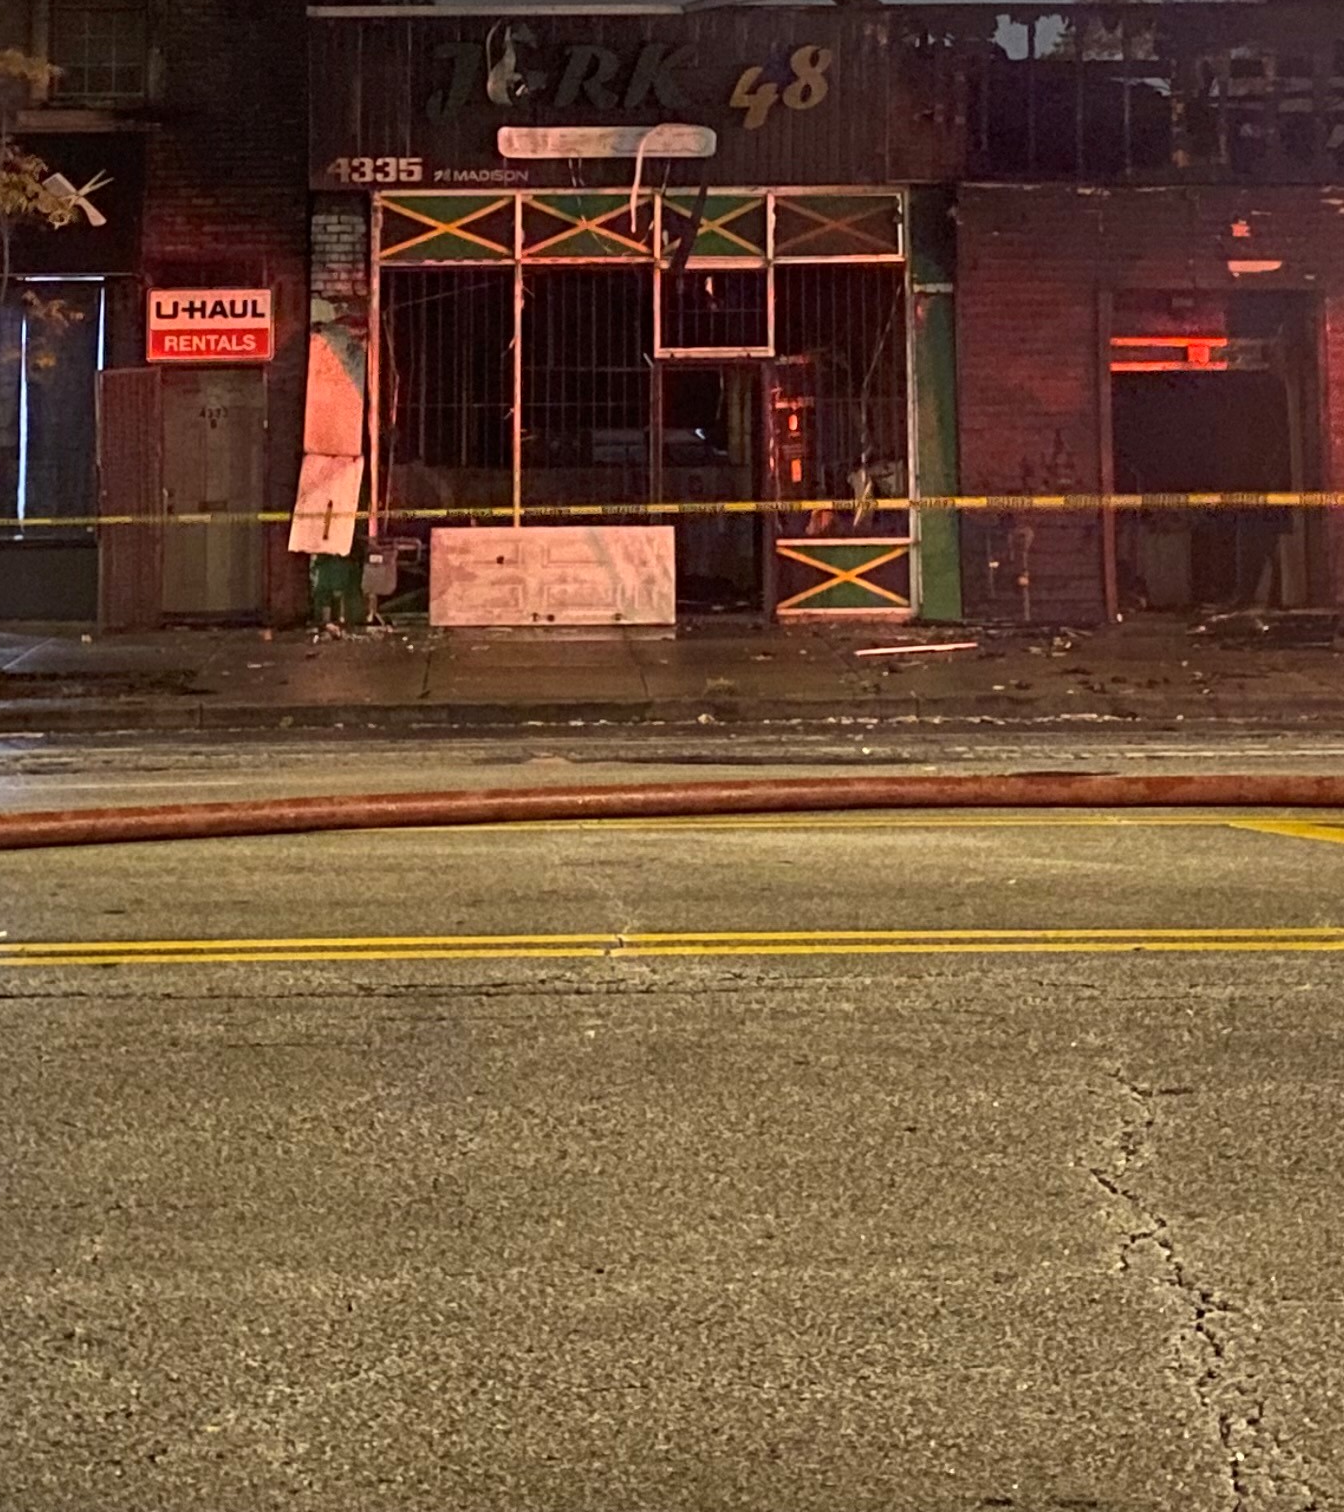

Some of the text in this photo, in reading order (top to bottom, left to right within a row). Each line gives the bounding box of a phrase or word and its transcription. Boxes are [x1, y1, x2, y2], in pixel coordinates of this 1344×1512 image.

[729, 45, 831, 129] 48
[327, 157, 424, 183] 4335
[453, 169, 530, 183] MADISON
[155, 299, 266, 320] U-HAUL
[163, 334, 257, 352] RENTALS
